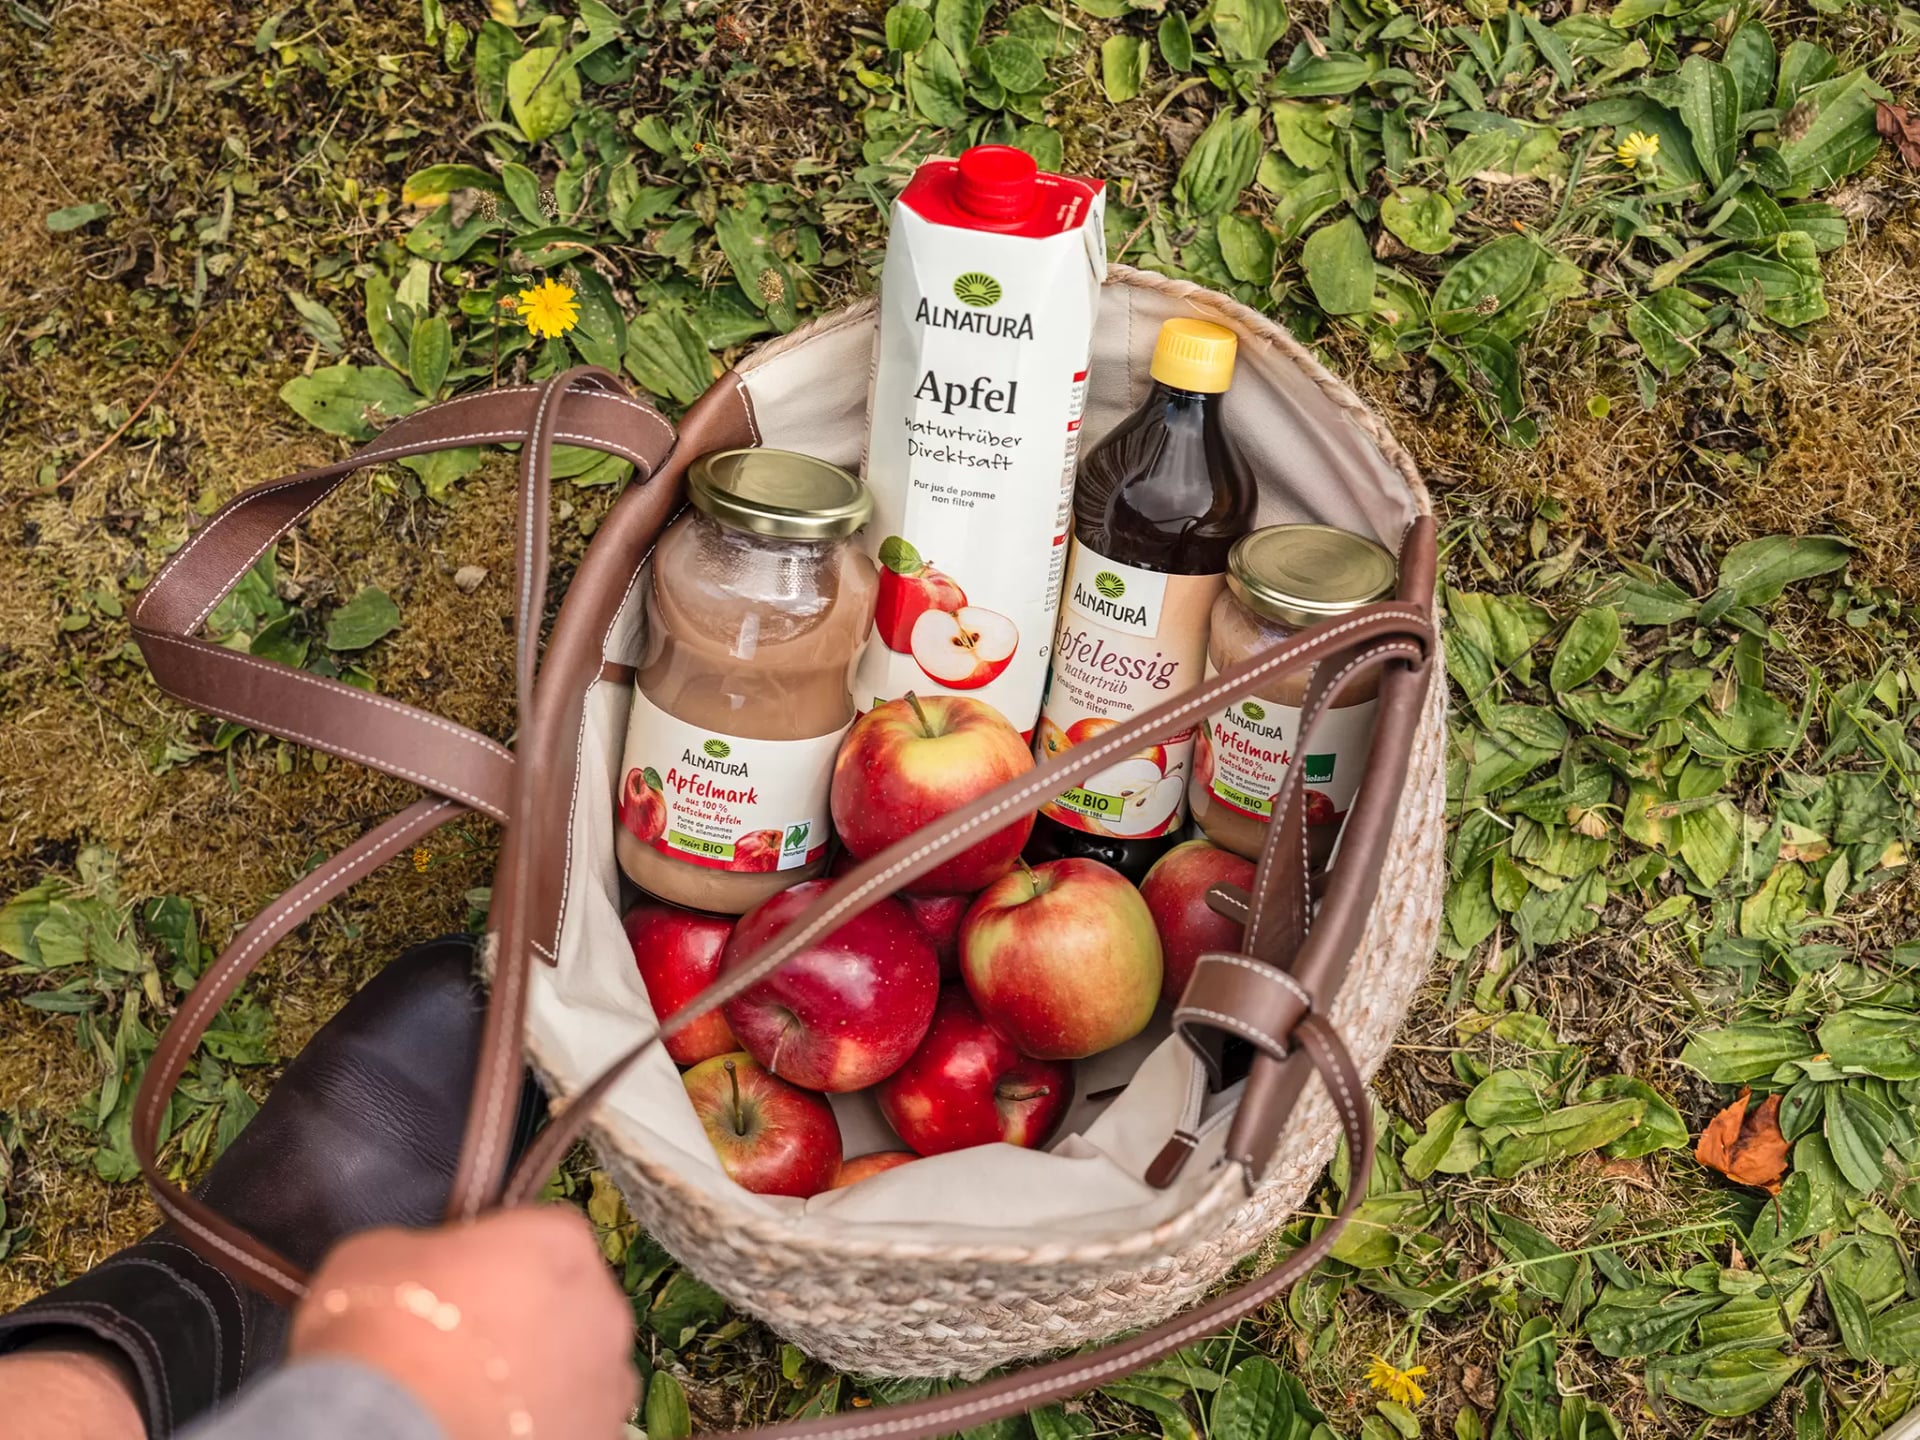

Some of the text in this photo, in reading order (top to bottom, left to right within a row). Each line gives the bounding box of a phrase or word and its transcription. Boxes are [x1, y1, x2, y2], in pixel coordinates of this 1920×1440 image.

[915, 297, 1033, 340] ALNATURA
[913, 370, 1018, 415] Apfel
[905, 417, 1022, 448] naturtrüber
[908, 438, 1013, 470] Direktsaft
[914, 479, 996, 500] Pur jus de pomme
[931, 495, 975, 508] non filtré
[1073, 582, 1147, 627] ALNATURA
[1064, 662, 1128, 695] naturtrüb
[1056, 673, 1134, 712] Vinaigre de pomme,
[1069, 694, 1108, 715] non filtré
[1224, 706, 1283, 740] ALNATURA
[1214, 723, 1291, 766] Apfelmark
[681, 748, 749, 777] ALNATURA
[1241, 756, 1254, 767] 100
[666, 768, 758, 804] Apfelmark
[1305, 773, 1331, 782] ioland
[685, 797, 699, 807] aus
[702, 800, 717, 811] 100
[1060, 789, 1108, 810] ein BIO
[1243, 796, 1262, 809] BIO
[672, 801, 742, 825] deutschen Äpfeln
[677, 822, 688, 830] 100
[695, 829, 731, 840] allemandes
[705, 824, 732, 833] pommes
[702, 842, 724, 854] BIO
